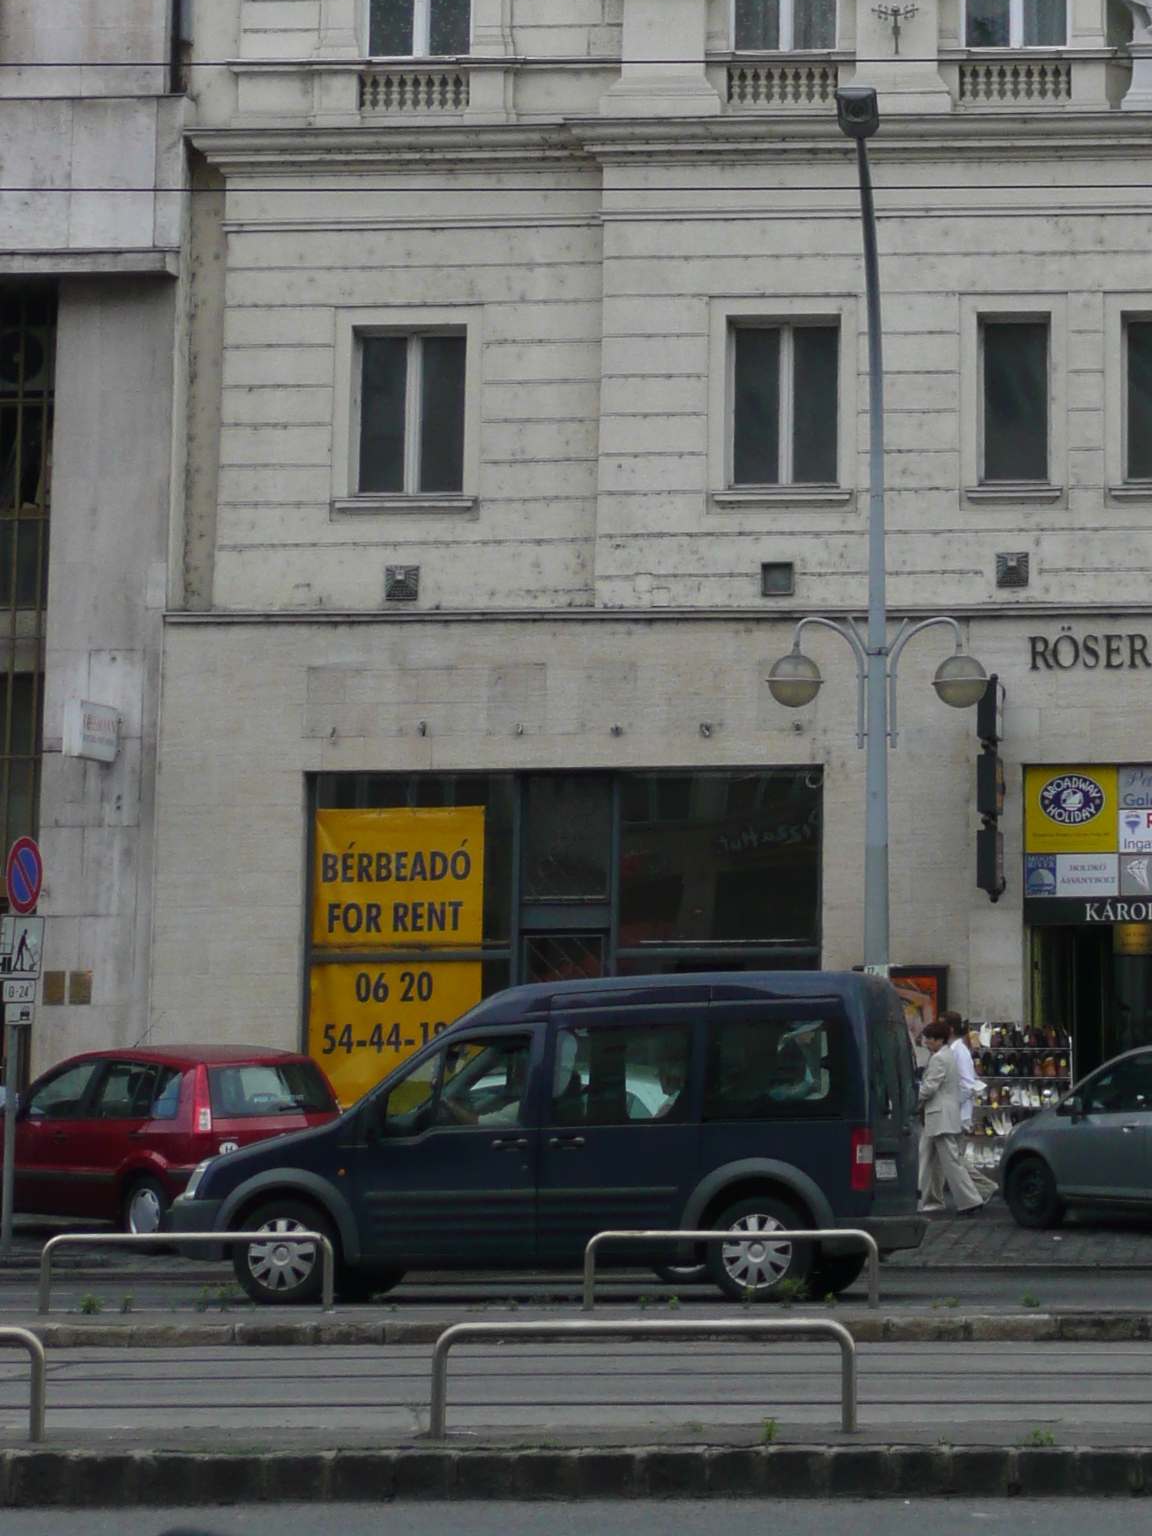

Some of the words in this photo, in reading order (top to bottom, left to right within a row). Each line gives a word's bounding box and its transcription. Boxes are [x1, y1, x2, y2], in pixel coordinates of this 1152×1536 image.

[1028, 626, 1152, 670] RÖSER
[1043, 777, 1102, 800] BROADWAY
[1046, 803, 1097, 823] HOLIDAY
[321, 838, 472, 883] BÉRBEADÓ
[327, 902, 383, 933] FOR
[392, 901, 464, 933] RENT
[355, 972, 390, 1003] 06
[399, 970, 434, 1002] 20
